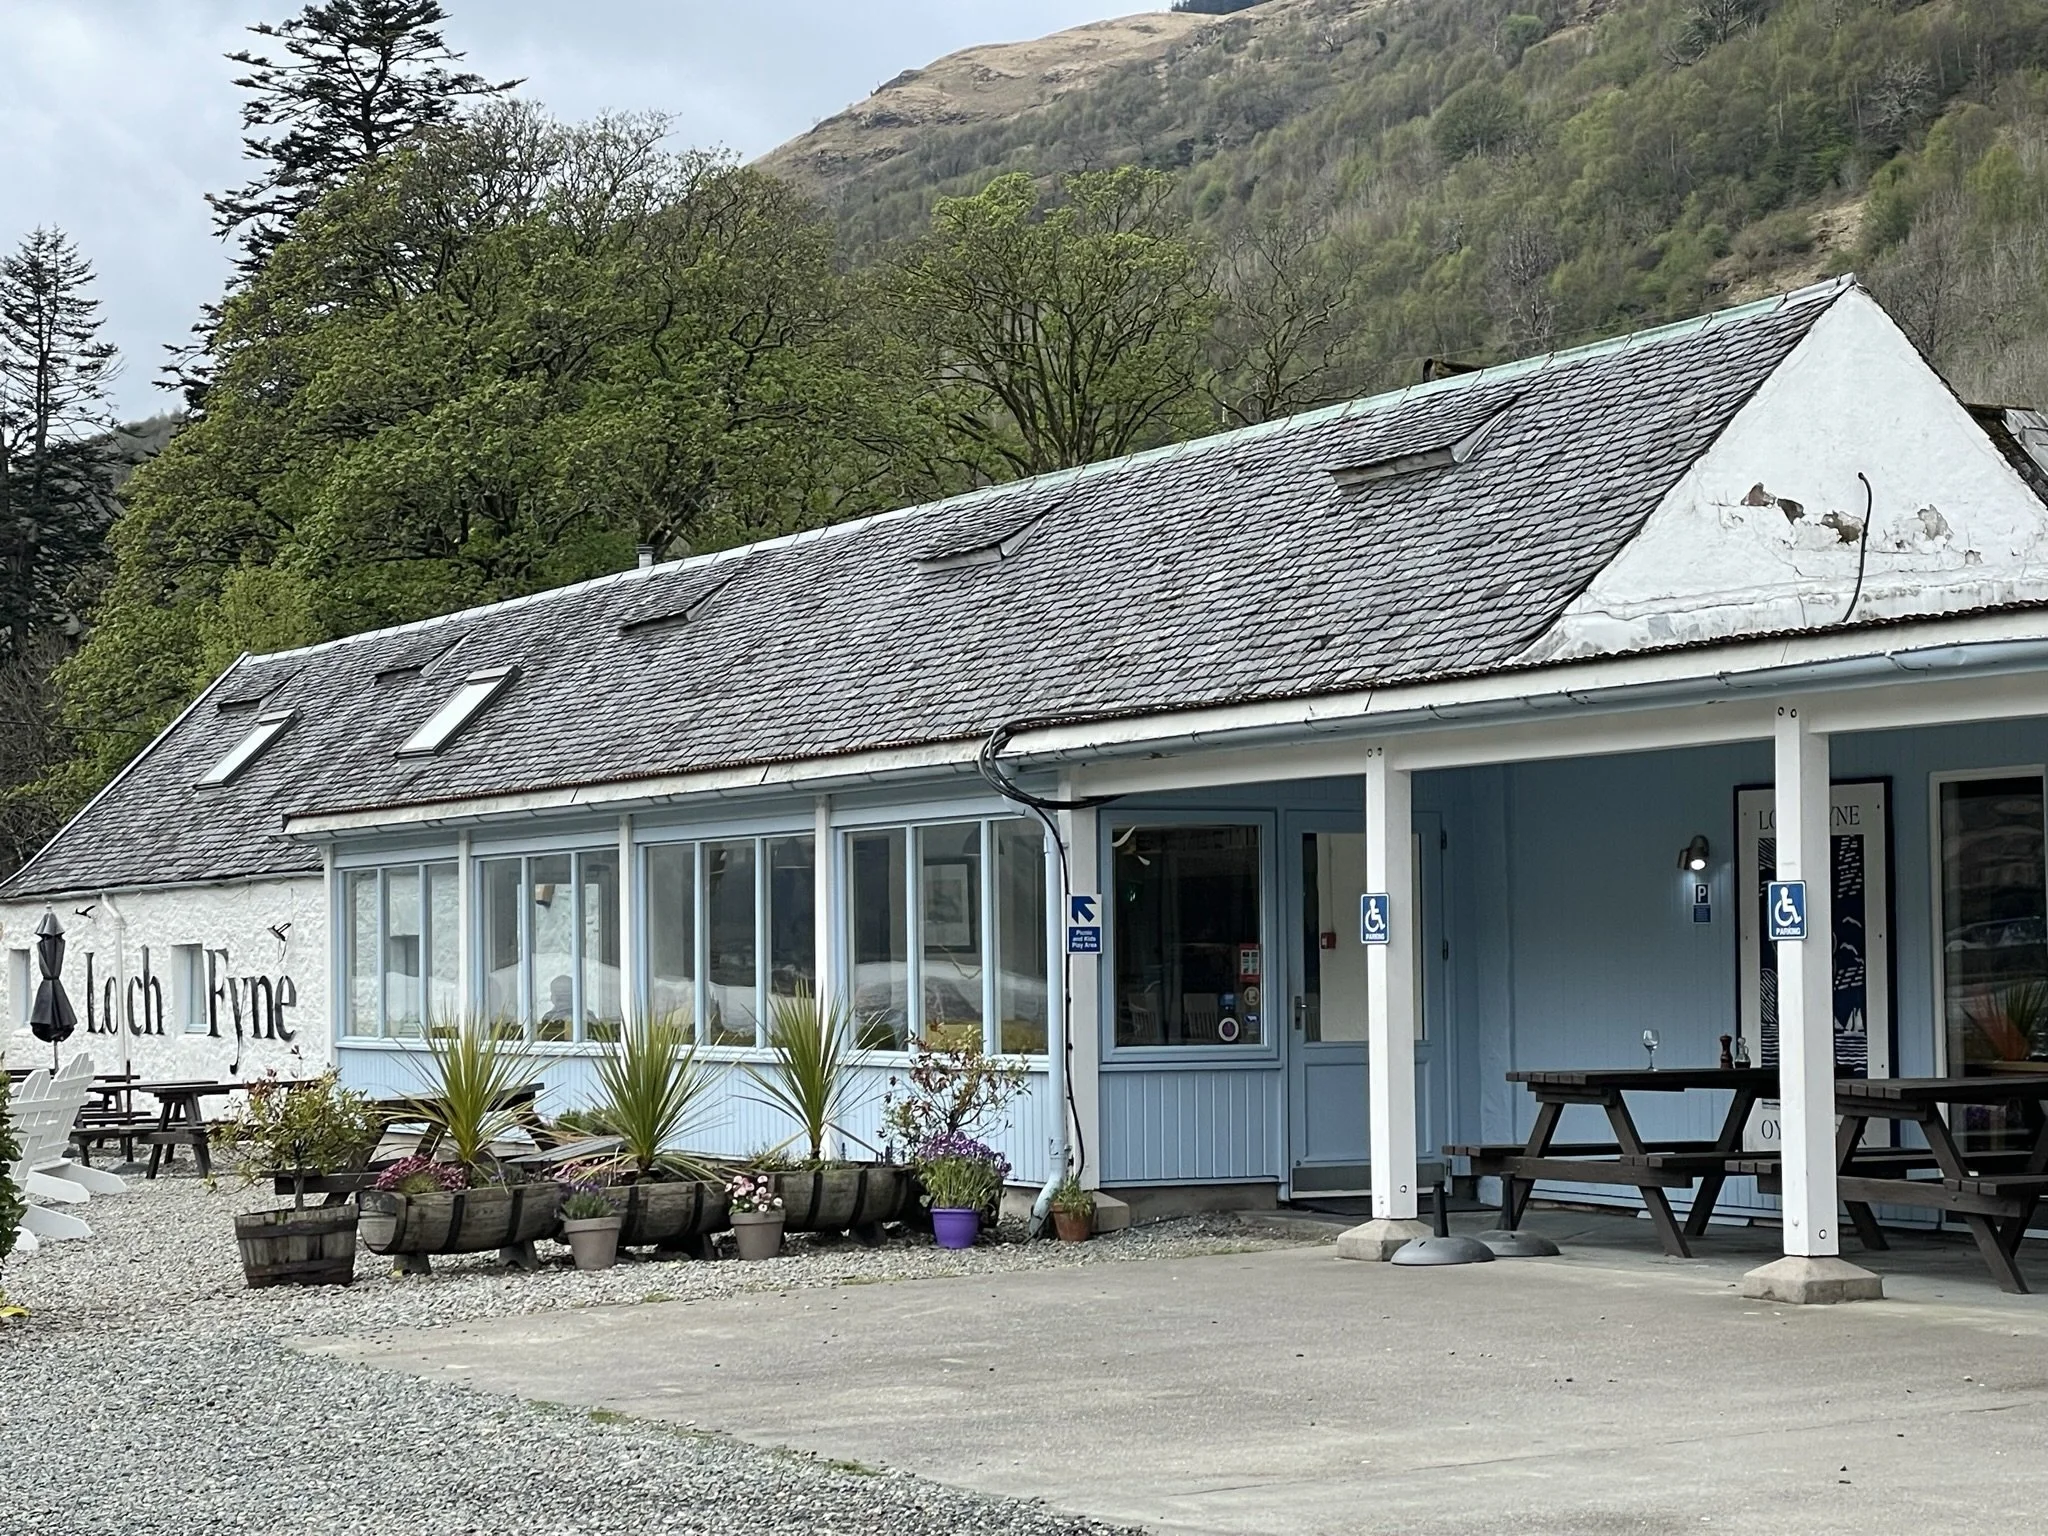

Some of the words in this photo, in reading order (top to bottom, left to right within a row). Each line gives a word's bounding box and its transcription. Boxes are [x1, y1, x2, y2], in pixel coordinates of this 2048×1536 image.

[1698, 886, 1706, 902] P
[1775, 927, 1801, 936] PARKING
[85, 944, 165, 1036] Loch
[204, 948, 298, 1075] Fyne
